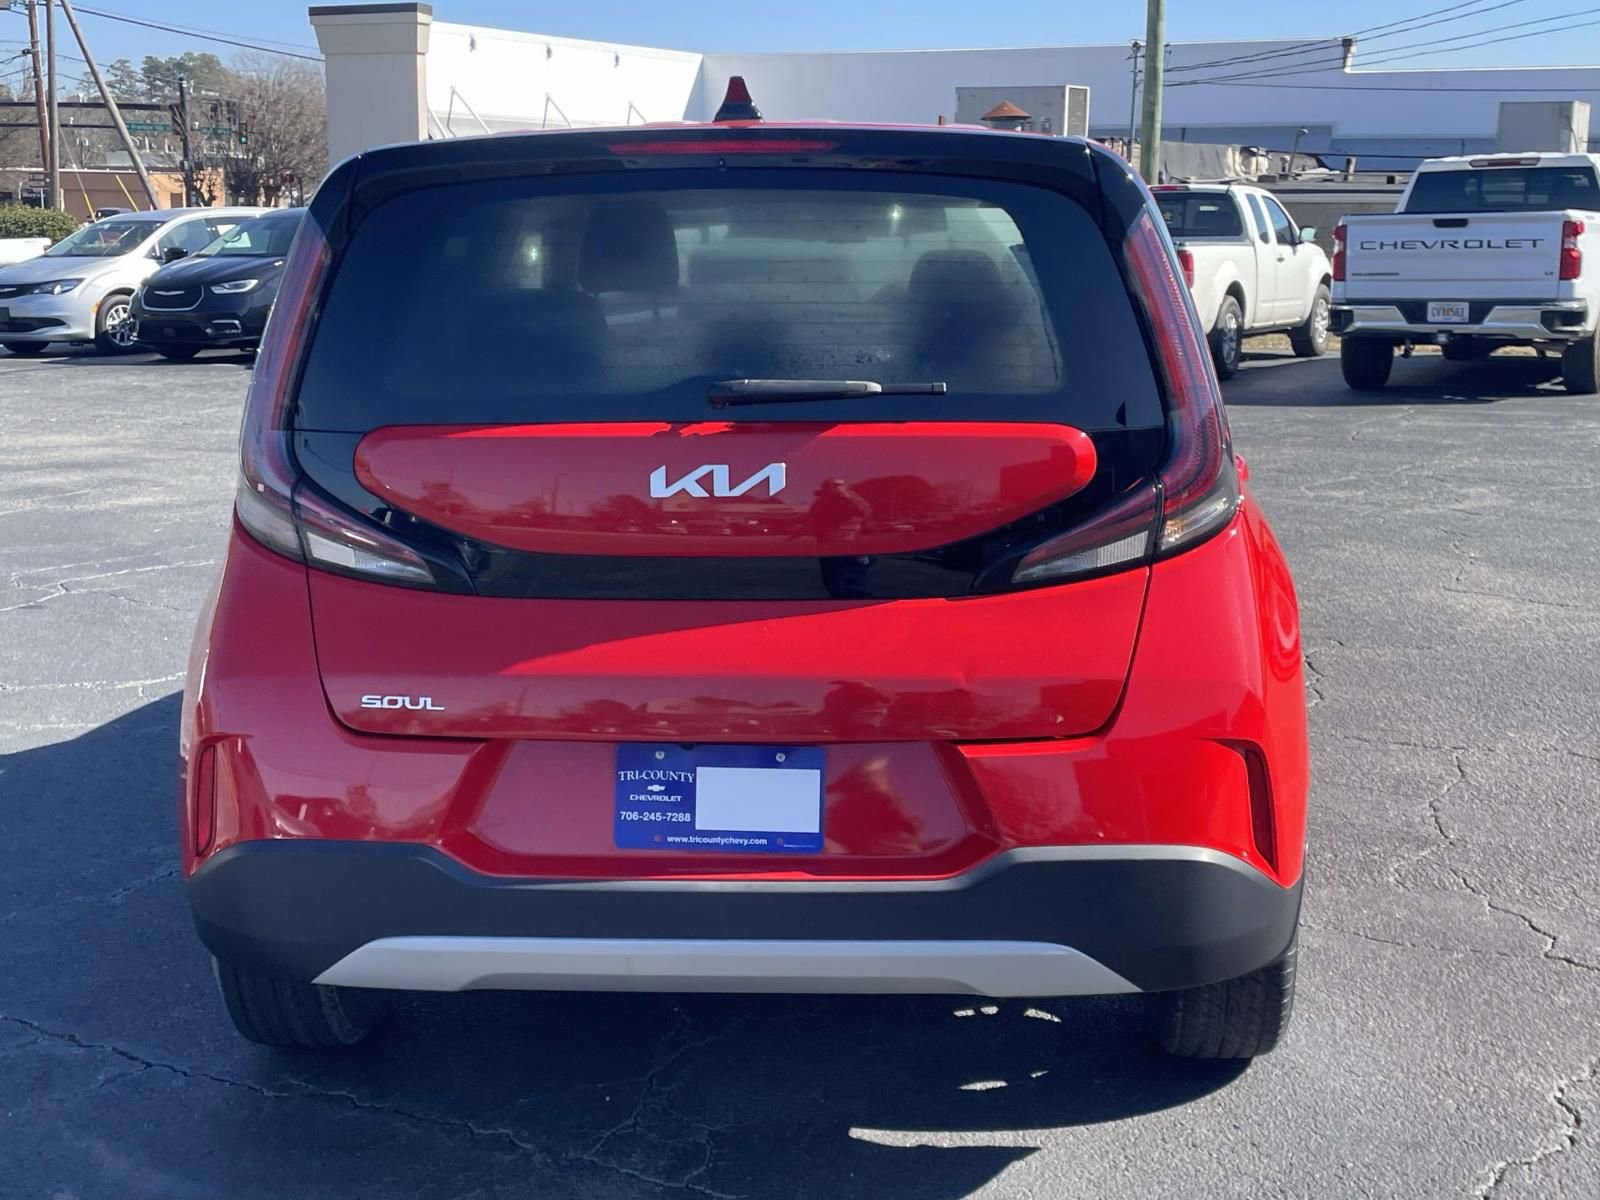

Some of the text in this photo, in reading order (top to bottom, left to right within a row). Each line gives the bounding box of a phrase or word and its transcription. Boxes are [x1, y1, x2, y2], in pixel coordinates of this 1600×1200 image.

[1360, 238, 1545, 250] CHEVROLET
[650, 462, 786, 498] KIA
[361, 694, 446, 711] SOUL
[618, 769, 695, 783] TRI-COUNTY
[629, 794, 683, 802] CHEVROLET
[619, 811, 691, 822] 706-245-7288
[666, 835, 768, 846] www.tricountychevy.com
